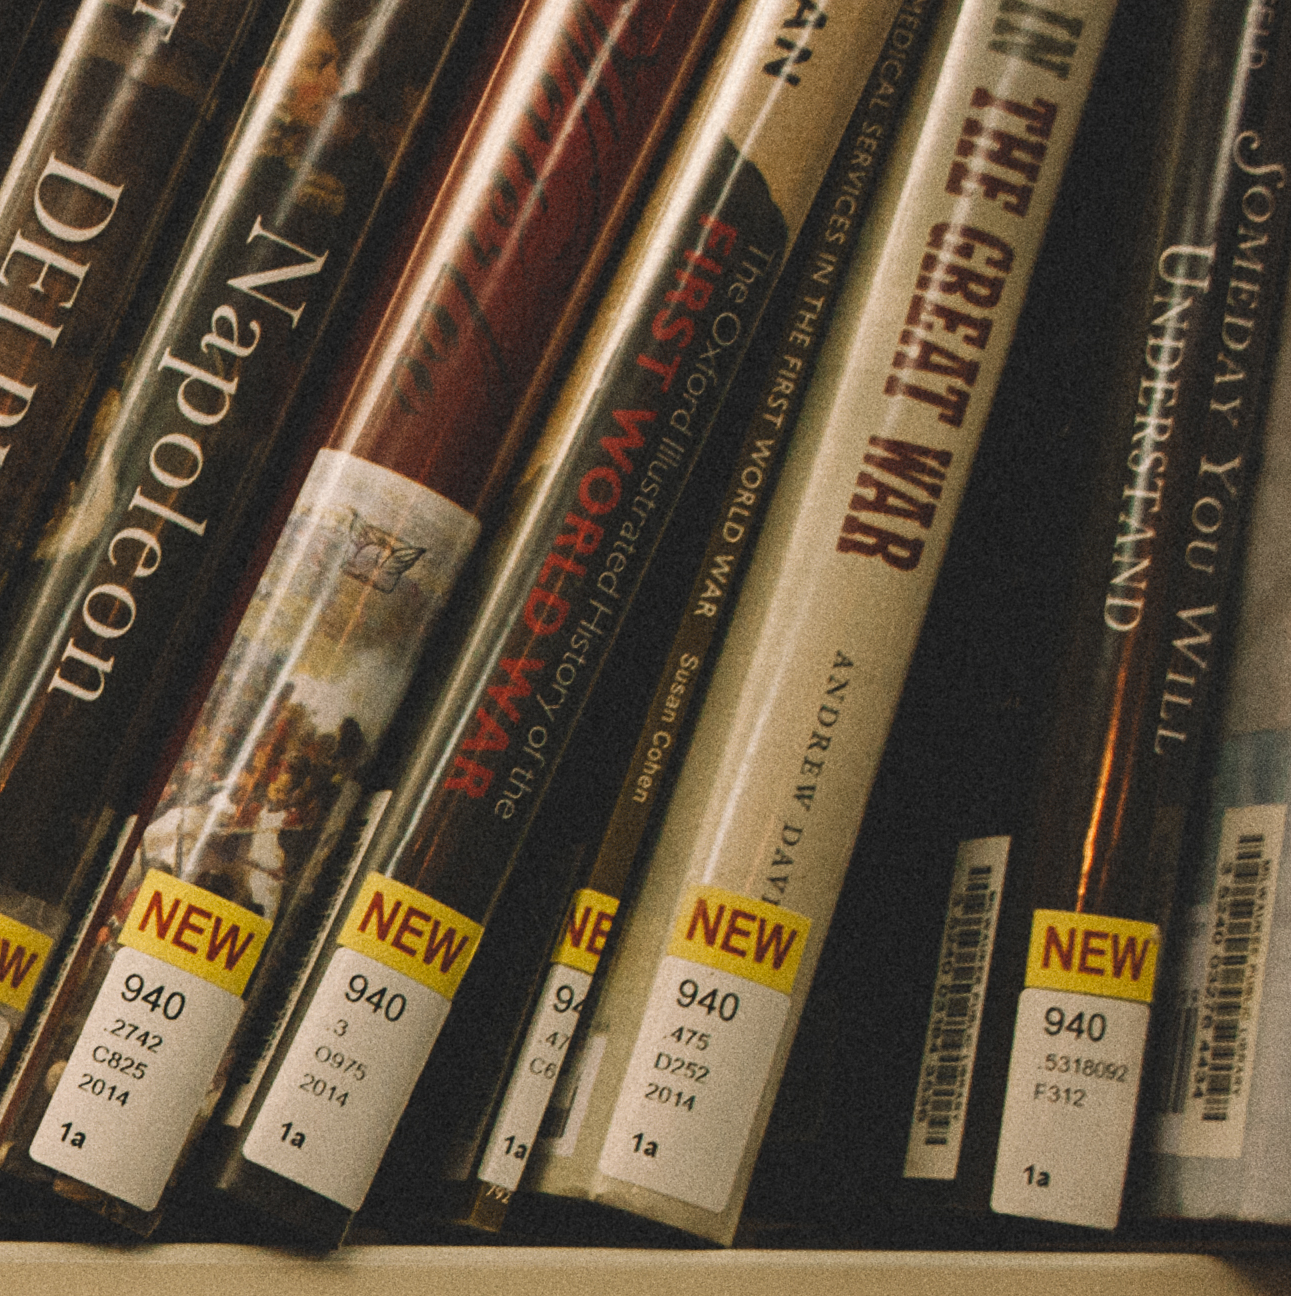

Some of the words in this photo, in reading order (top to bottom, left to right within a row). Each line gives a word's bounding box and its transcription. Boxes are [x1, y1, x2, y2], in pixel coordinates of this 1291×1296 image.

[826, 121, 884, 245] SERVICES
[943, 87, 1059, 218] THE
[636, 214, 738, 393] FIRST
[1210, 130, 1286, 413] SOMEDAY
[789, 296, 825, 347] THE
[884, 222, 1017, 428] GREAT
[763, 355, 802, 430] FIRST
[48, 215, 330, 702] Napoleon
[1102, 243, 1217, 633] UNDERSTAND
[524, 408, 658, 637] WORLD
[718, 438, 776, 544] WORLD
[835, 433, 955, 572] WAR
[1183, 454, 1244, 575] YOU
[692, 555, 734, 619] WAR
[536, 599, 611, 721] History
[662, 652, 699, 724] Susan
[1154, 604, 1216, 755] WILL
[444, 657, 546, 798] WAR
[632, 731, 671, 802] Cohen
[792, 650, 854, 813] ANDREW
[138, 891, 255, 971] NEW
[359, 891, 469, 973] NEW
[686, 899, 797, 970] NEW
[1041, 925, 1150, 981] NEW
[119, 973, 186, 1021] 940
[344, 973, 407, 1023] 940
[676, 979, 740, 1022] 940
[1043, 1007, 1107, 1042] 940
[77, 1073, 130, 1106] 2014
[91, 1044, 149, 1081] C825
[299, 1073, 351, 1108] 2014
[644, 1083, 697, 1112] 2014
[653, 1052, 711, 1084] D252
